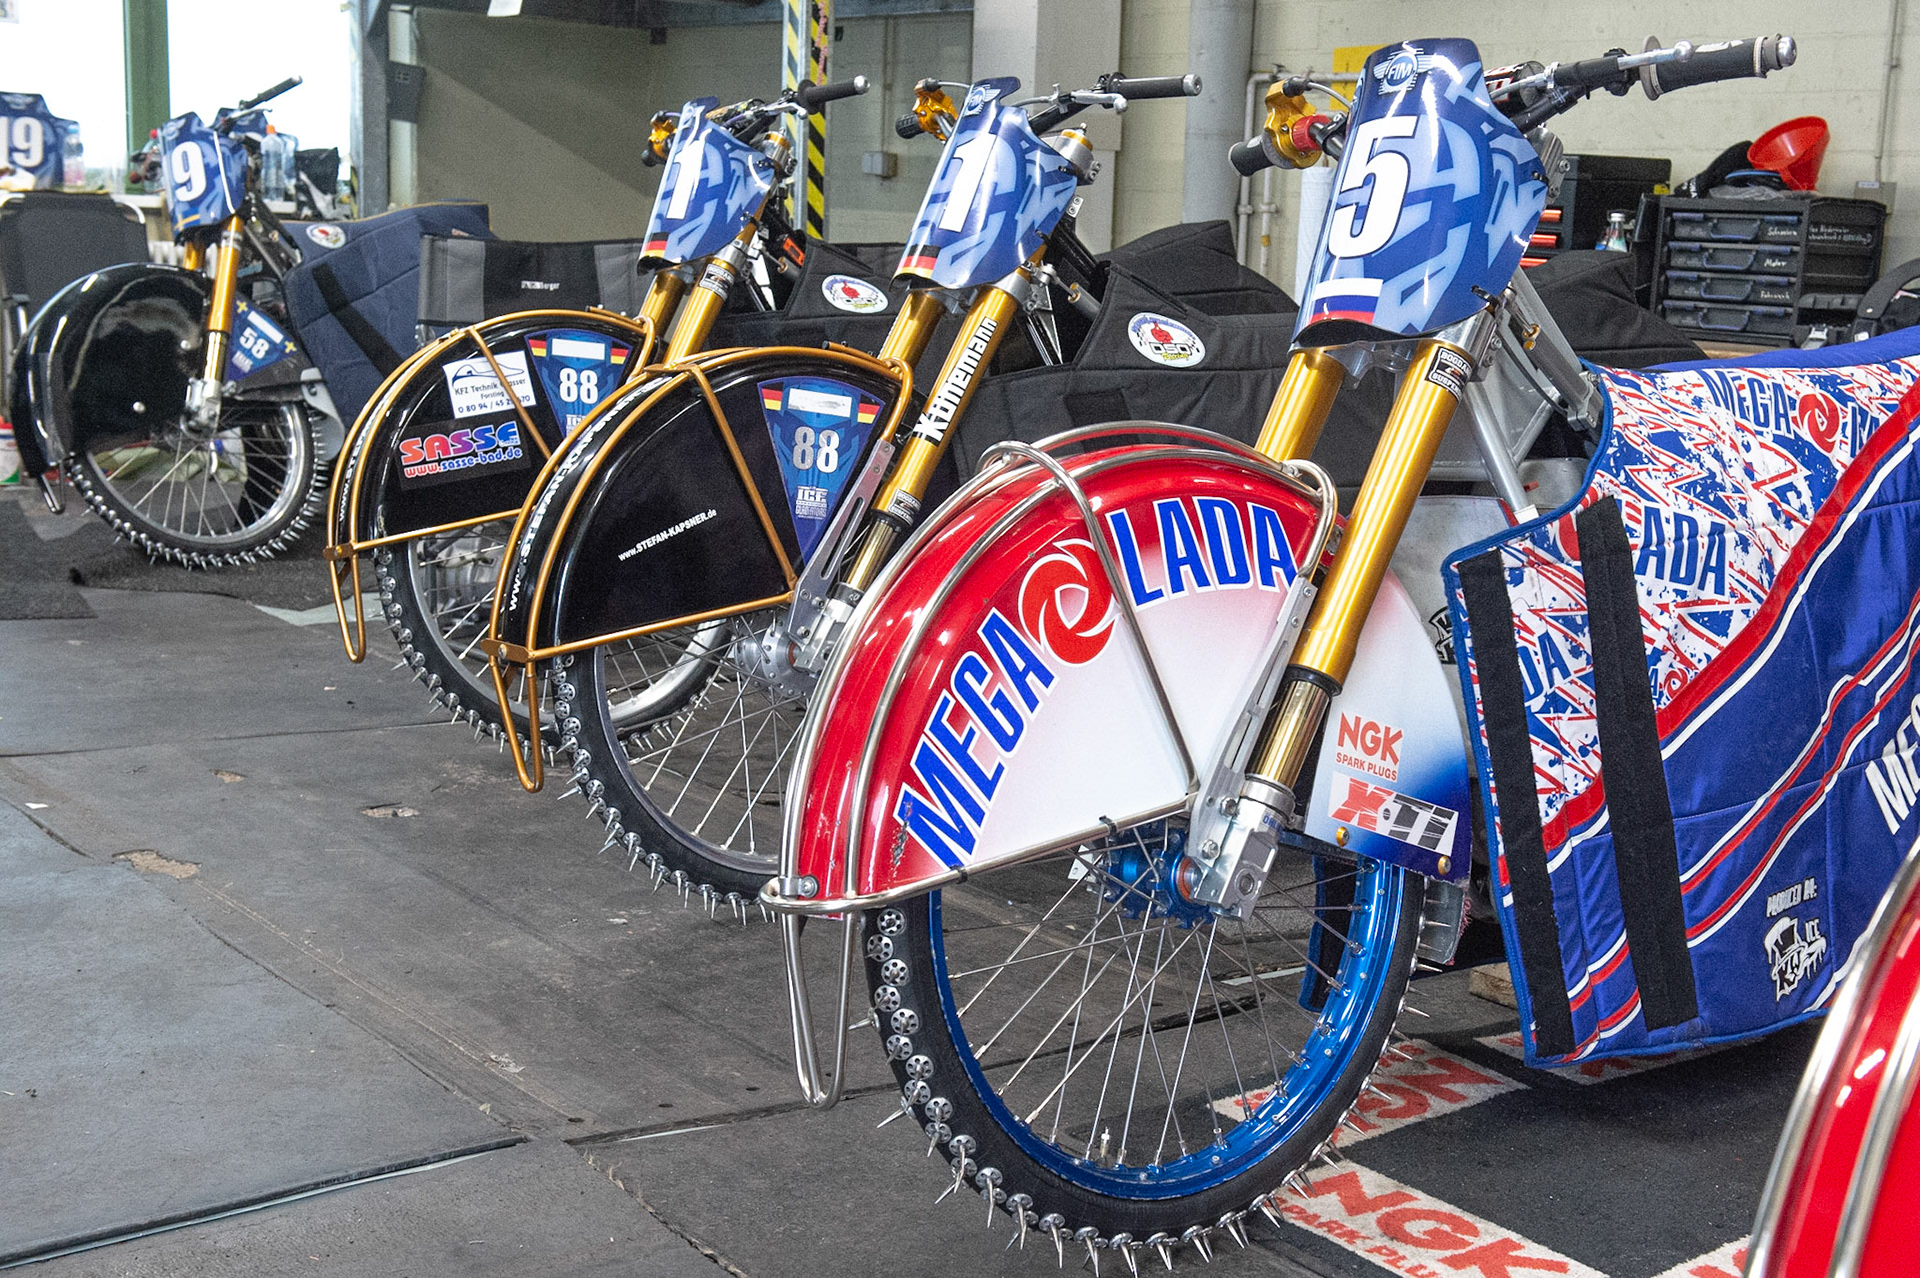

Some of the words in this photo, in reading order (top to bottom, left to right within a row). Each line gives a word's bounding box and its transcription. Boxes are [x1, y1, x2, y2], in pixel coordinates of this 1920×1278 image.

[1388, 62, 1413, 80] FIM
[172, 141, 207, 201] 9
[666, 140, 702, 219] 1
[938, 132, 998, 233] 1
[1328, 115, 1418, 259] 5
[239, 326, 270, 359] 58
[455, 385, 470, 396] KFZ
[470, 381, 499, 393] Technik
[465, 404, 477, 413] 80
[560, 367, 599, 405] 88
[1700, 368, 1793, 438] MEGA
[400, 420, 521, 465] SASSE
[403, 446, 523, 479] www.sasse-bad.de
[792, 425, 840, 474] 88
[797, 487, 829, 502] ICE
[618, 508, 718, 561] www.STEFAN-KAPSNER.de
[1105, 497, 1299, 611] LADA
[1634, 505, 1726, 596] ADA
[893, 607, 1060, 872] MEGA
[1337, 712, 1403, 766] NGK
[1335, 752, 1366, 771] SPARK
[1367, 762, 1398, 781] PLUGS
[1804, 918, 1821, 943] ICE
[1287, 1170, 1569, 1278] NGK
